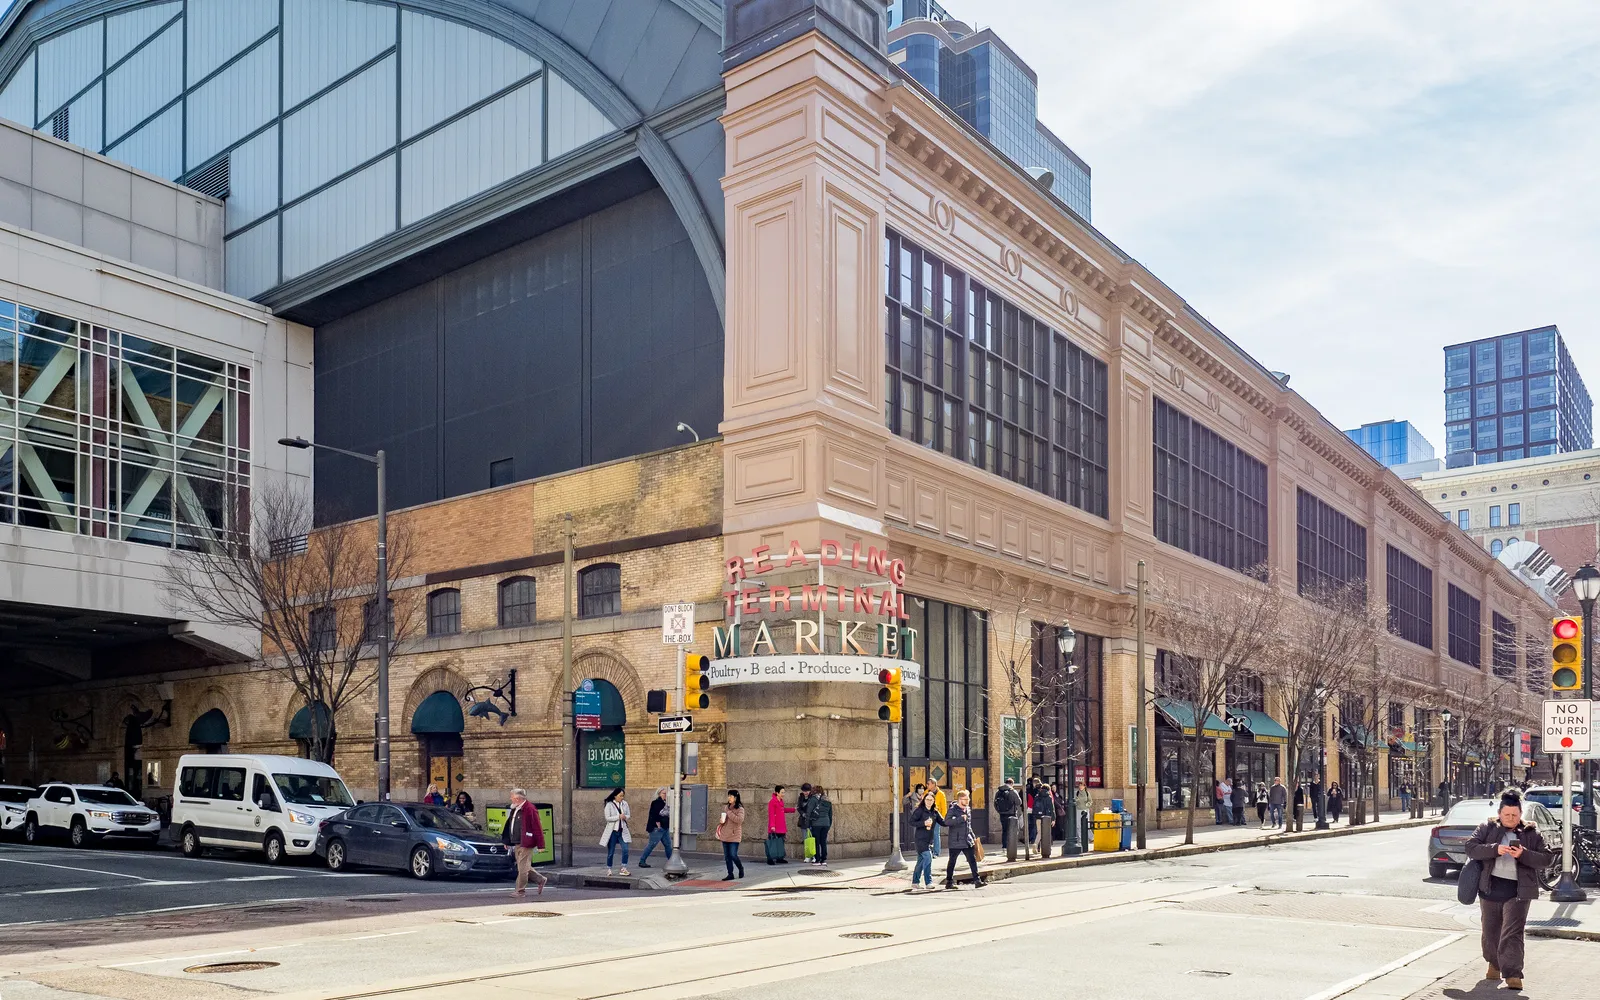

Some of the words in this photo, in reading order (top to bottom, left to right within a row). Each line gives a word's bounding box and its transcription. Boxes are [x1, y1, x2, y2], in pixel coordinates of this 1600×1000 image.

[726, 539, 906, 587] READING
[723, 584, 910, 619] TERMINAL
[678, 604, 693, 612] BLOCK
[664, 634, 676, 643] THE
[678, 633, 692, 642] BOX
[711, 619, 918, 661] MARKET
[711, 666, 741, 680] Poultry
[798, 660, 851, 675] Produce
[1556, 704, 1578, 714] NO
[1551, 716, 1584, 725] TURN
[1546, 727, 1562, 735] ON
[1567, 726, 1588, 735] RED
[587, 749, 598, 761] 131
[599, 748, 624, 761] YEARS
